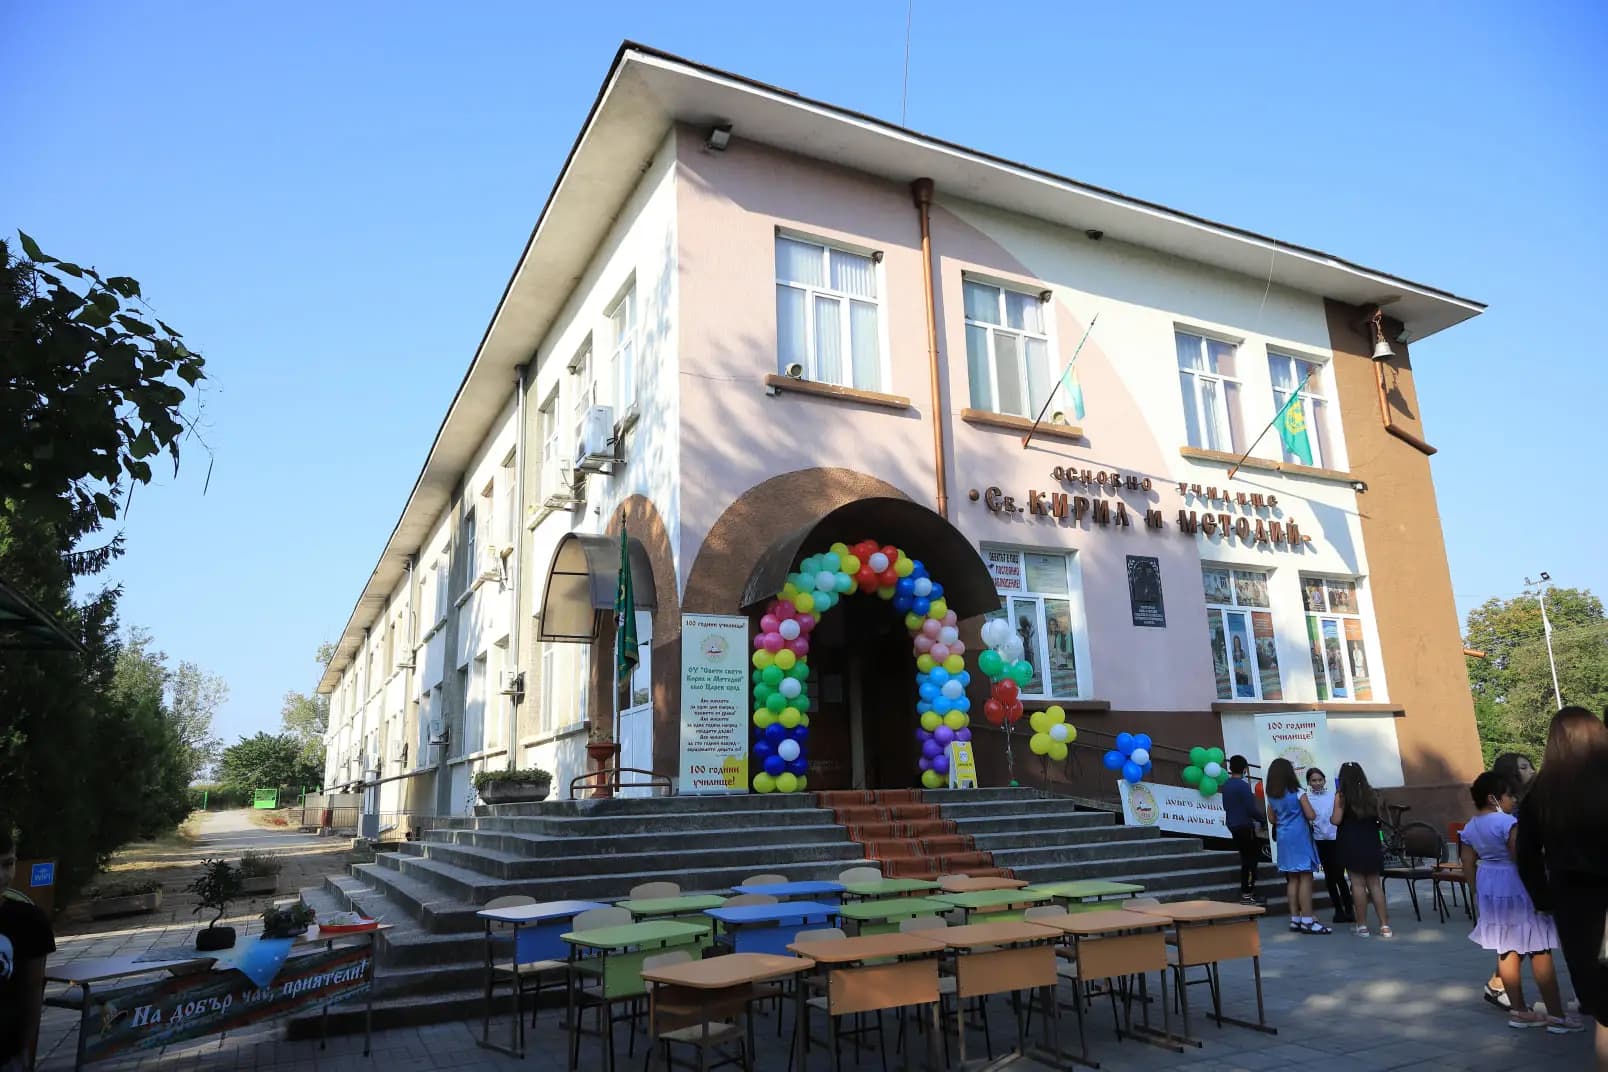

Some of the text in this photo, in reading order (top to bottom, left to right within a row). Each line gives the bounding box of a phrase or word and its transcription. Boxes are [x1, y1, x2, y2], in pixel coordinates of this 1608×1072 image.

[1053, 466, 1152, 492] ОСНОВНО
[1028, 489, 1130, 526] КИРИЛ
[1268, 721, 1316, 730] 100 години
[1272, 731, 1313, 743] училище!
[690, 765, 740, 775] 100 години
[693, 776, 736, 789] училище!
[131, 1004, 161, 1028] На
[170, 994, 233, 1024] добър
[283, 959, 370, 998] приятели!
